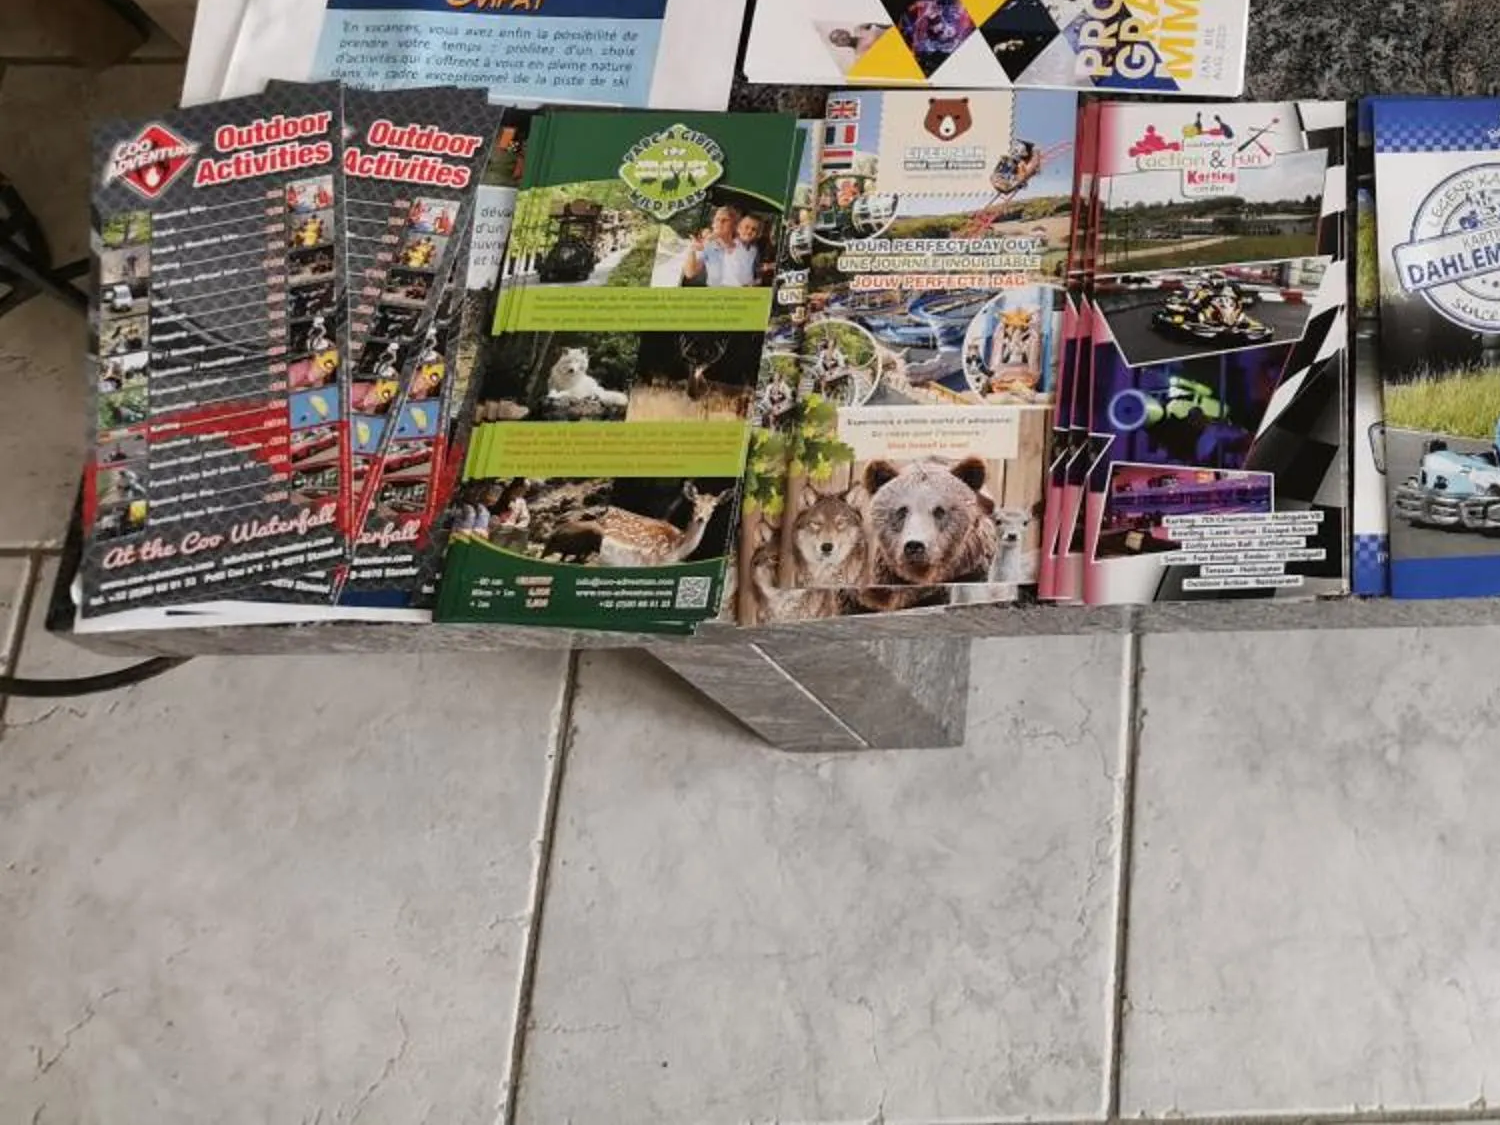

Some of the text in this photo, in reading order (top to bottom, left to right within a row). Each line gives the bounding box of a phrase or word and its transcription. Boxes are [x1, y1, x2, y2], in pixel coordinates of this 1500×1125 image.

[343, 22, 359, 33] En
[429, 26, 459, 36] vous
[465, 27, 494, 37] avez
[499, 27, 532, 39] enfin
[536, 28, 549, 40] la
[553, 29, 617, 43] possibilité
[622, 30, 638, 42] de
[339, 37, 389, 50] prendre
[399, 39, 431, 50] votre
[441, 40, 482, 53] temps
[564, 44, 593, 56] d'un
[495, 59, 525, 70] vous
[527, 60, 543, 70] en
[591, 61, 633, 73] nature
[425, 71, 510, 85] exceptionnel
[513, 73, 530, 84] de
[534, 73, 547, 85] la
[553, 75, 584, 88] piste
[589, 75, 606, 87] de
[612, 75, 630, 87] ski
[215, 110, 332, 151] Outdoor
[368, 119, 483, 157] Outdoor
[114, 139, 154, 162] COO
[1210, 150, 1225, 168] &
[192, 141, 332, 188] Activities
[344, 147, 472, 188] Activities
[1187, 171, 1236, 185] Karting
[846, 238, 1038, 253] YOUR PERFECT DAY OUT
[839, 257, 871, 271] UNE
[853, 276, 899, 289] JOUW
[102, 502, 337, 570] At the Coo Waterfall
